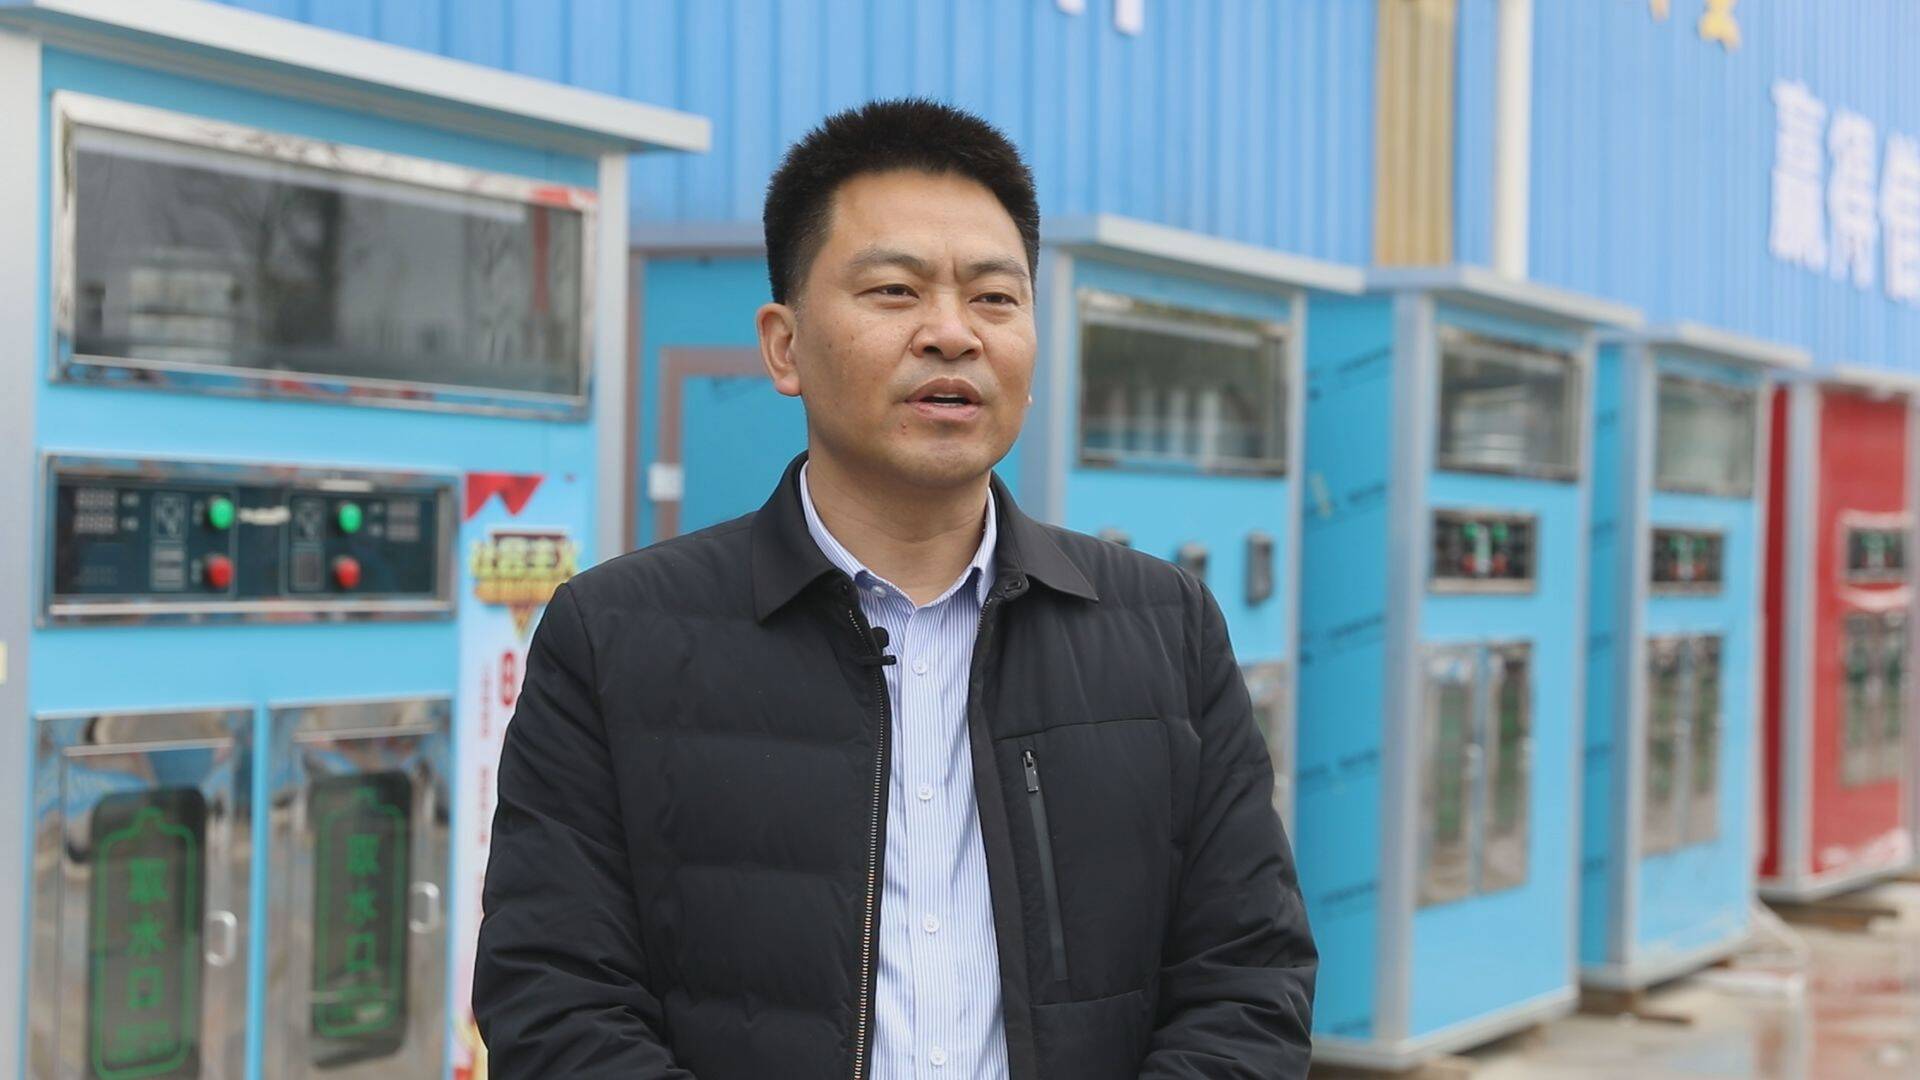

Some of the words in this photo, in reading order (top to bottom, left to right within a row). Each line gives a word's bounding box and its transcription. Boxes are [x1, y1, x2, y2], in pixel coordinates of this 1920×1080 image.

[128, 859, 169, 1010] 取水口
[345, 834, 380, 972] 取水口
